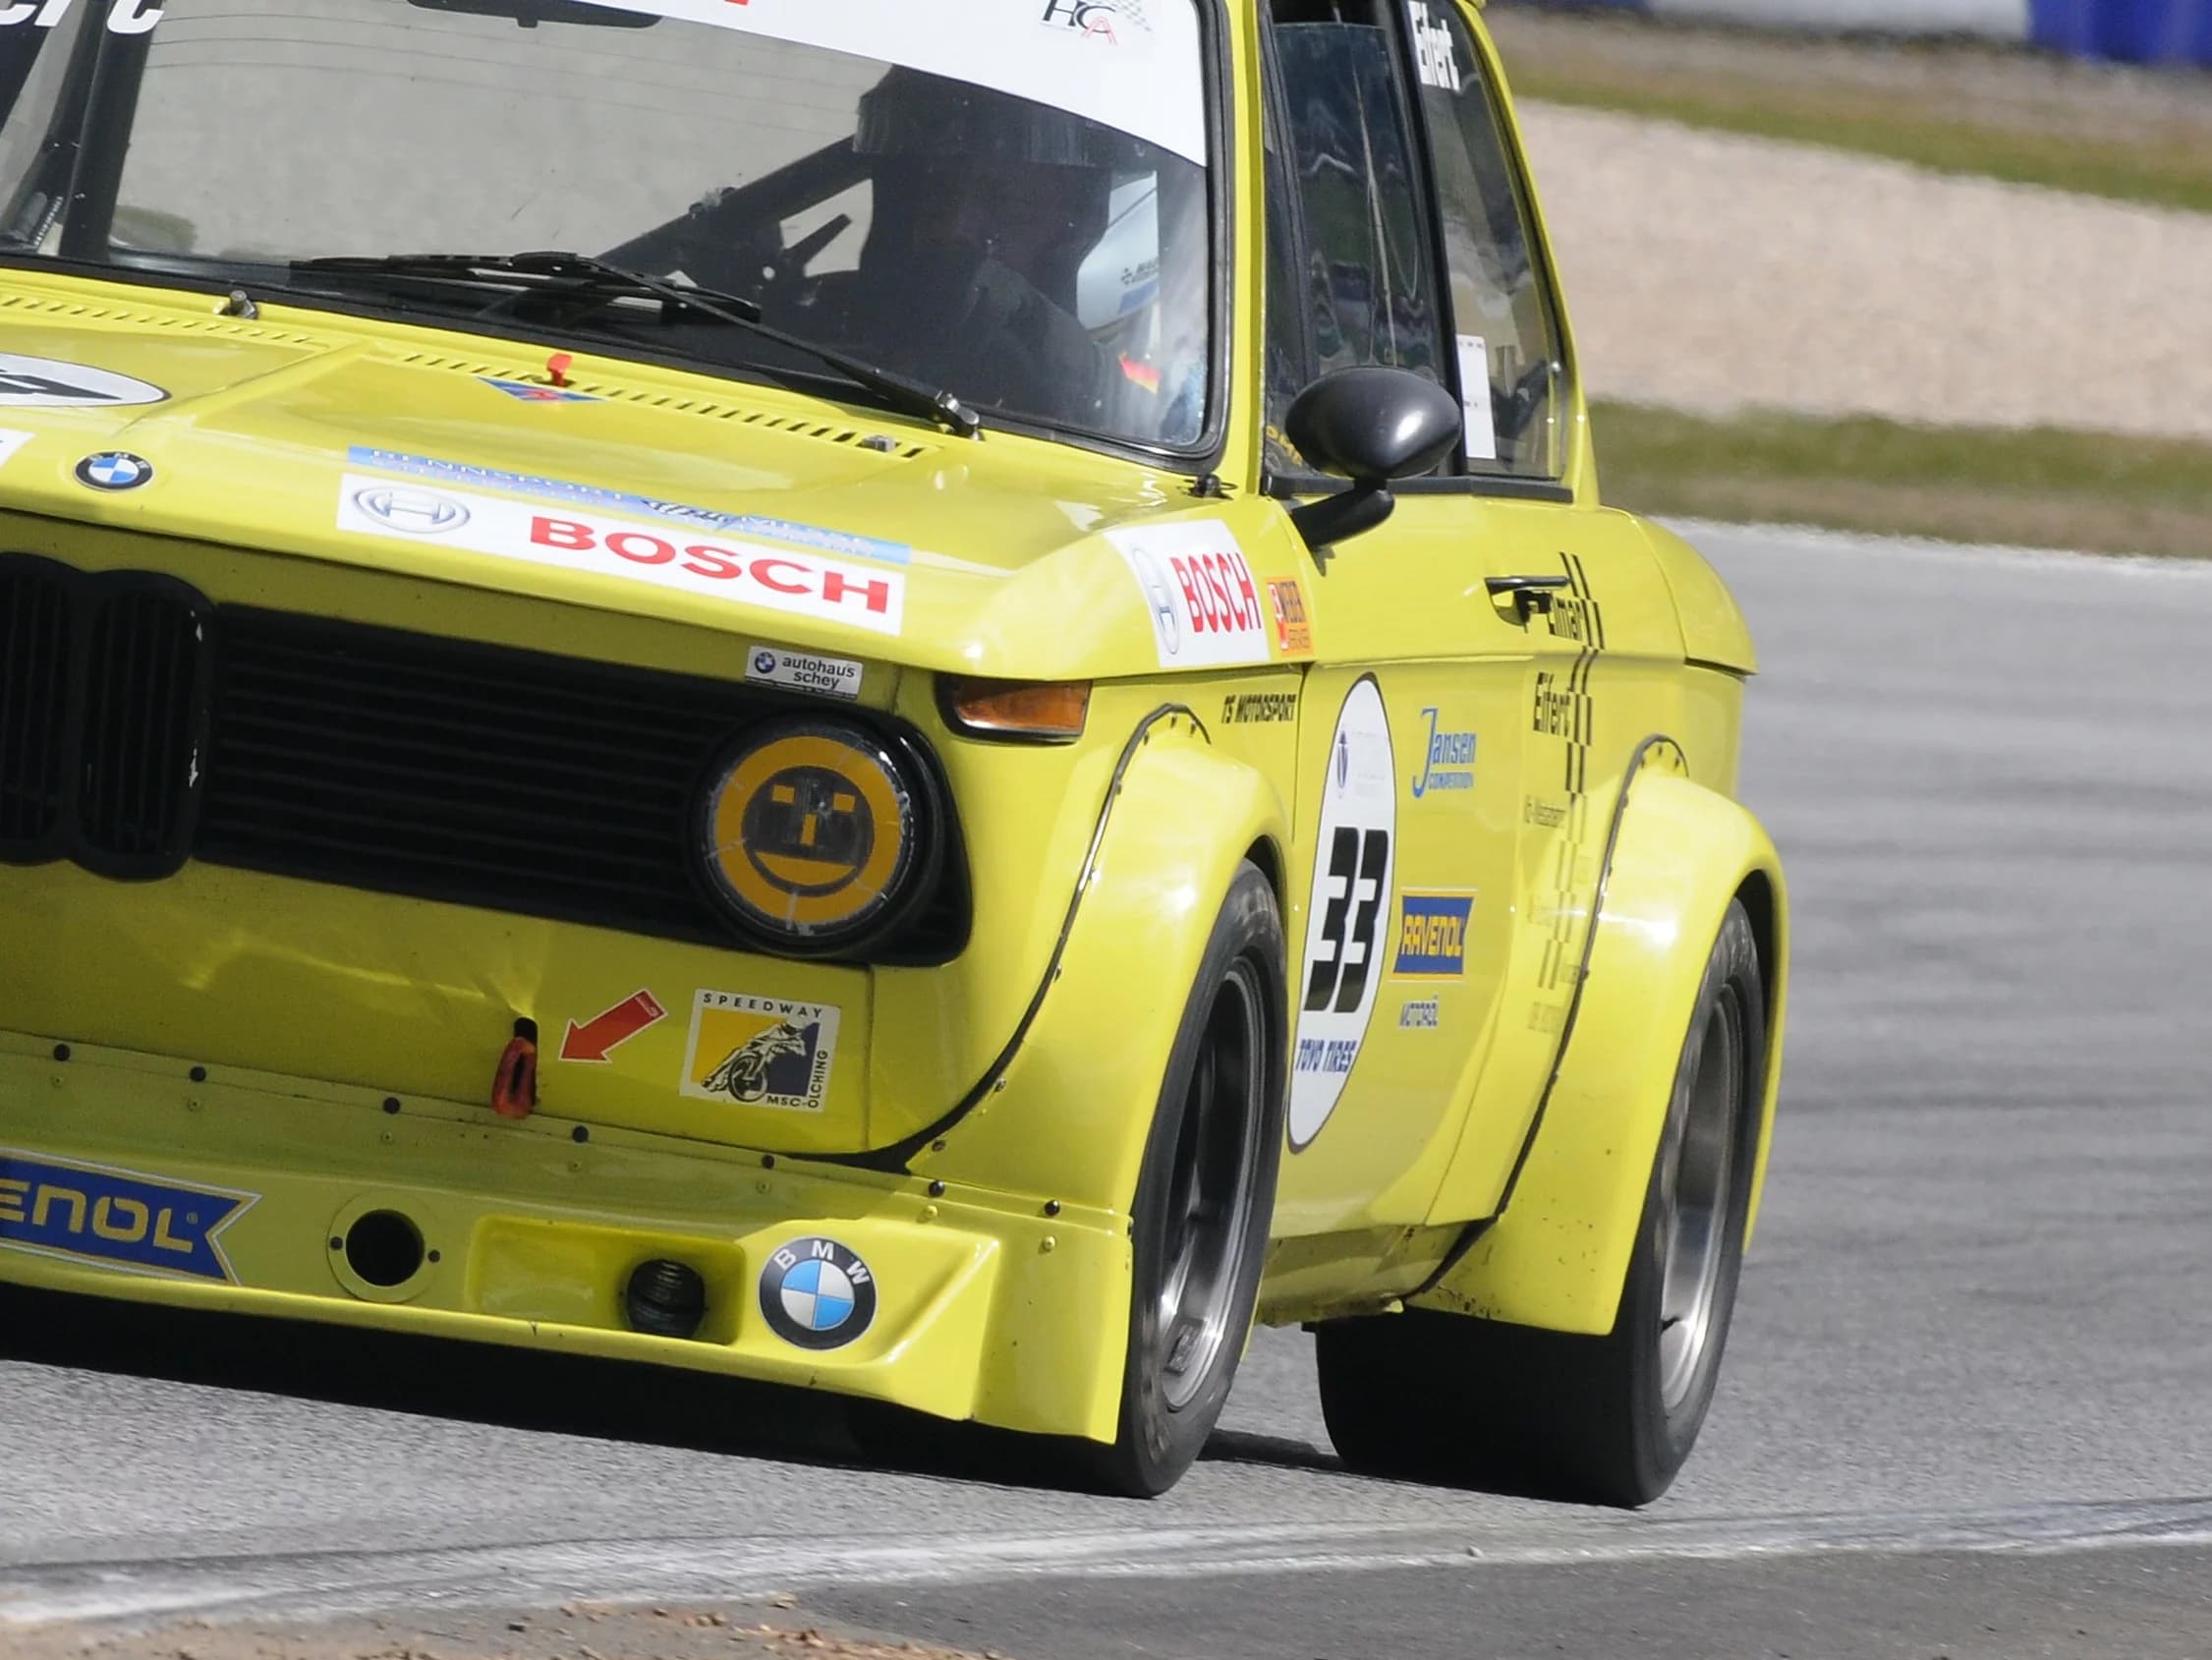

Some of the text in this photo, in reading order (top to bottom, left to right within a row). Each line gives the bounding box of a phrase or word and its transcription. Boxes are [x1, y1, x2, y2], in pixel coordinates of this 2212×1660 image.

[530, 516, 889, 614] BOSCH
[1169, 552, 1262, 633] BOSCH
[782, 656, 856, 678] autohaus
[793, 671, 840, 690] schey
[1235, 693, 1297, 722] MOTORSPORT
[1412, 707, 1477, 798] Jansen
[1303, 827, 1390, 1013] 33
[1401, 914, 1463, 957] RAVENOL
[703, 993, 822, 1019] SPEEDWAY
[1296, 1039, 1358, 1073] TOYO TIRES
[773, 1239, 871, 1286] BMW
